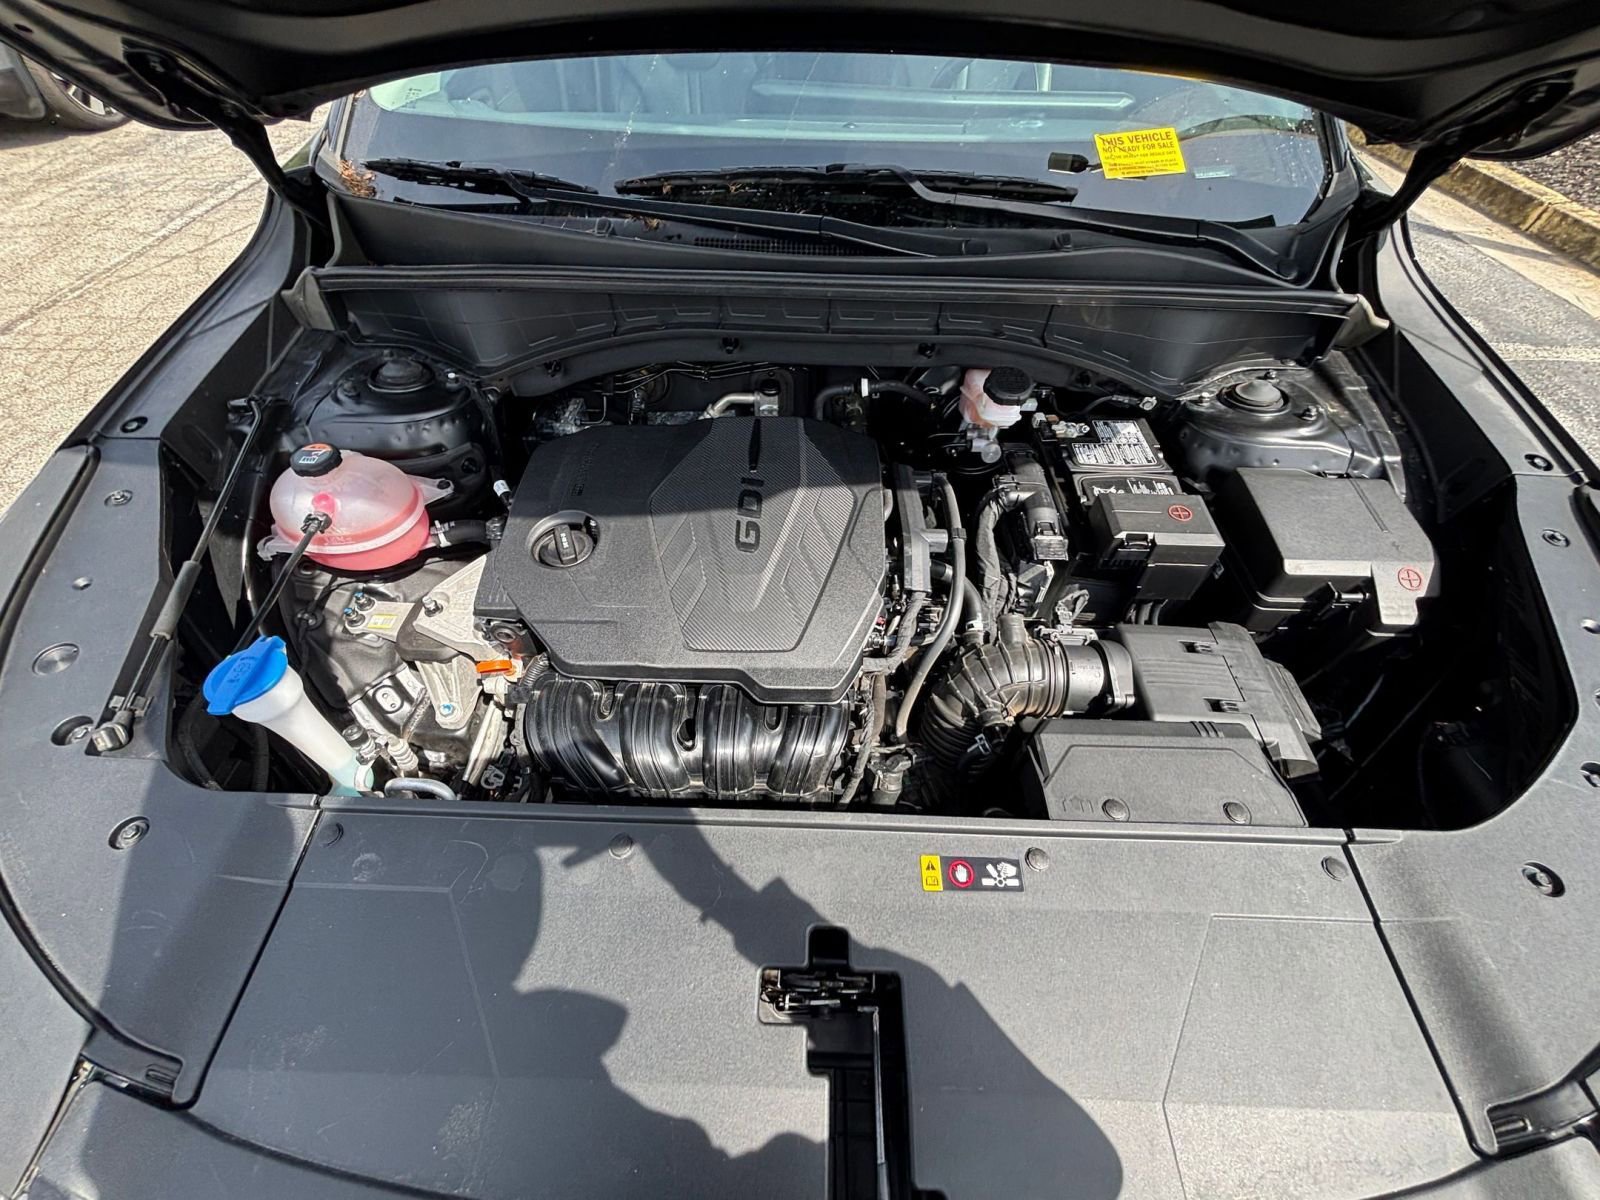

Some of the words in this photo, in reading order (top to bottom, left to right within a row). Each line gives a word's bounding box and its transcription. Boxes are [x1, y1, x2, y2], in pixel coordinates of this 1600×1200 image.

[1101, 136, 1125, 146] THIS
[1127, 131, 1172, 144] VEHICLE
[1102, 145, 1117, 153] NOT
[1142, 143, 1156, 151] FOR
[1157, 141, 1175, 149] SALE
